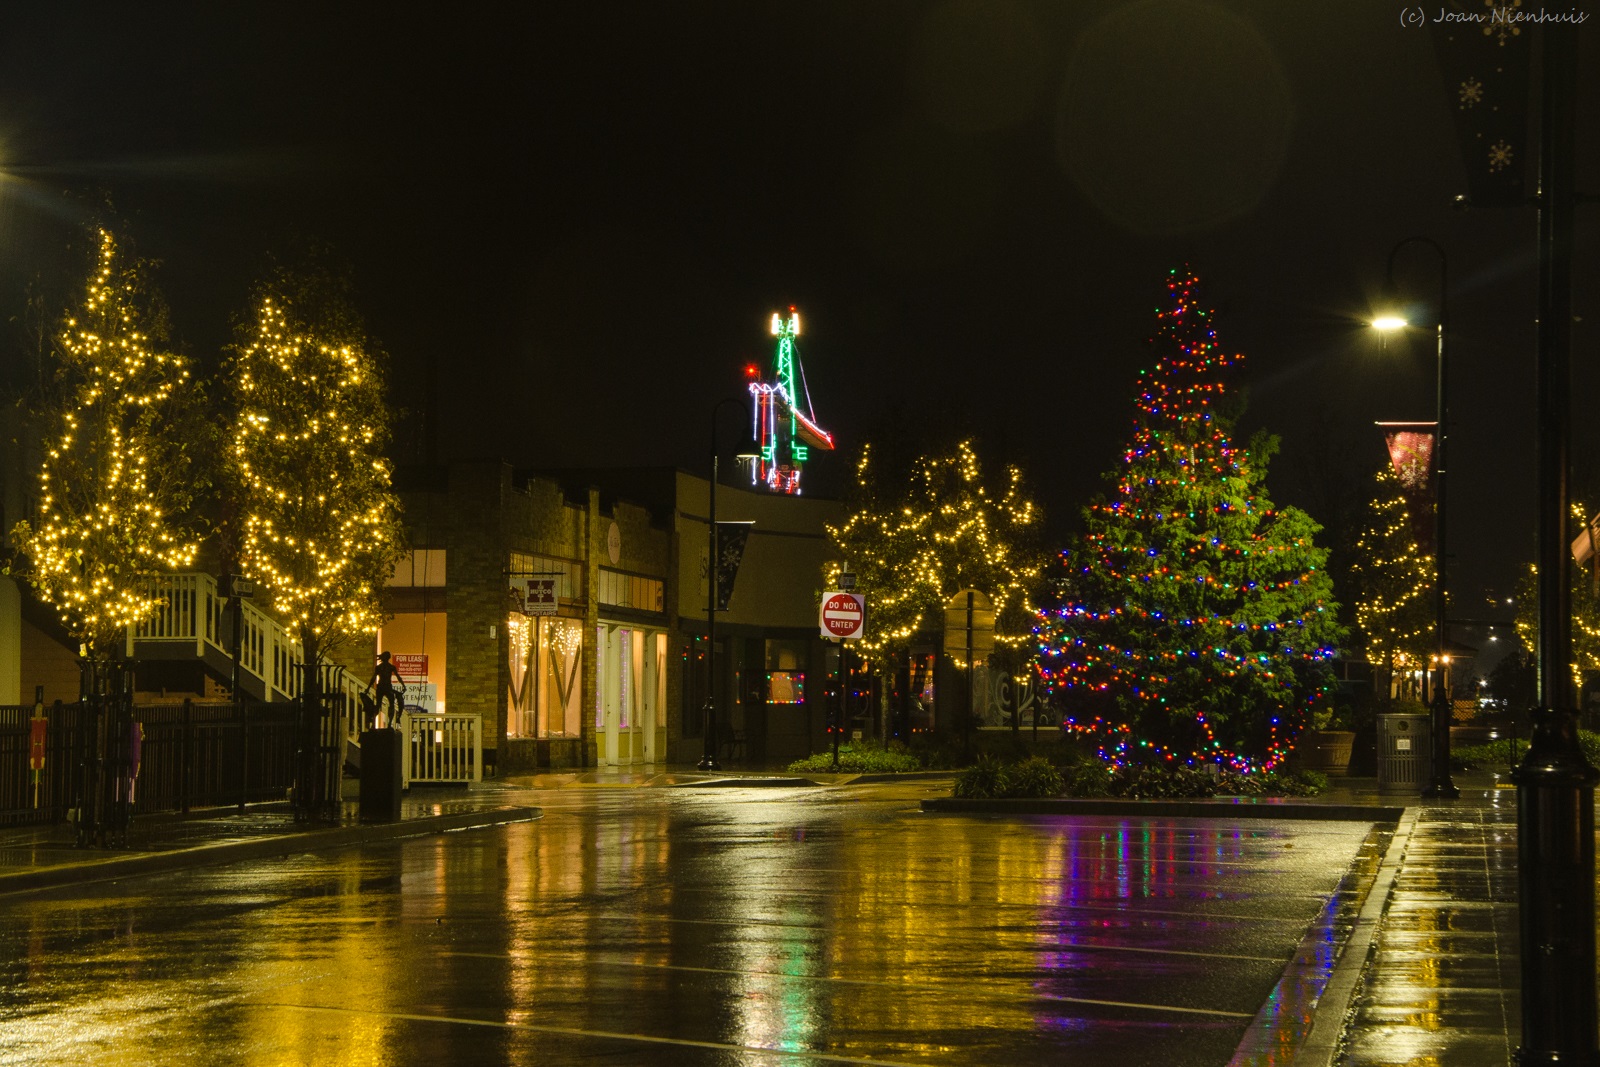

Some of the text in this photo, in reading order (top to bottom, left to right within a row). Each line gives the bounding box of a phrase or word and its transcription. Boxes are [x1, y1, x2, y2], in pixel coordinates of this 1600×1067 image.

[828, 601, 857, 610] DO NOT
[830, 620, 854, 629] ENTER
[409, 685, 428, 693] SPACE
